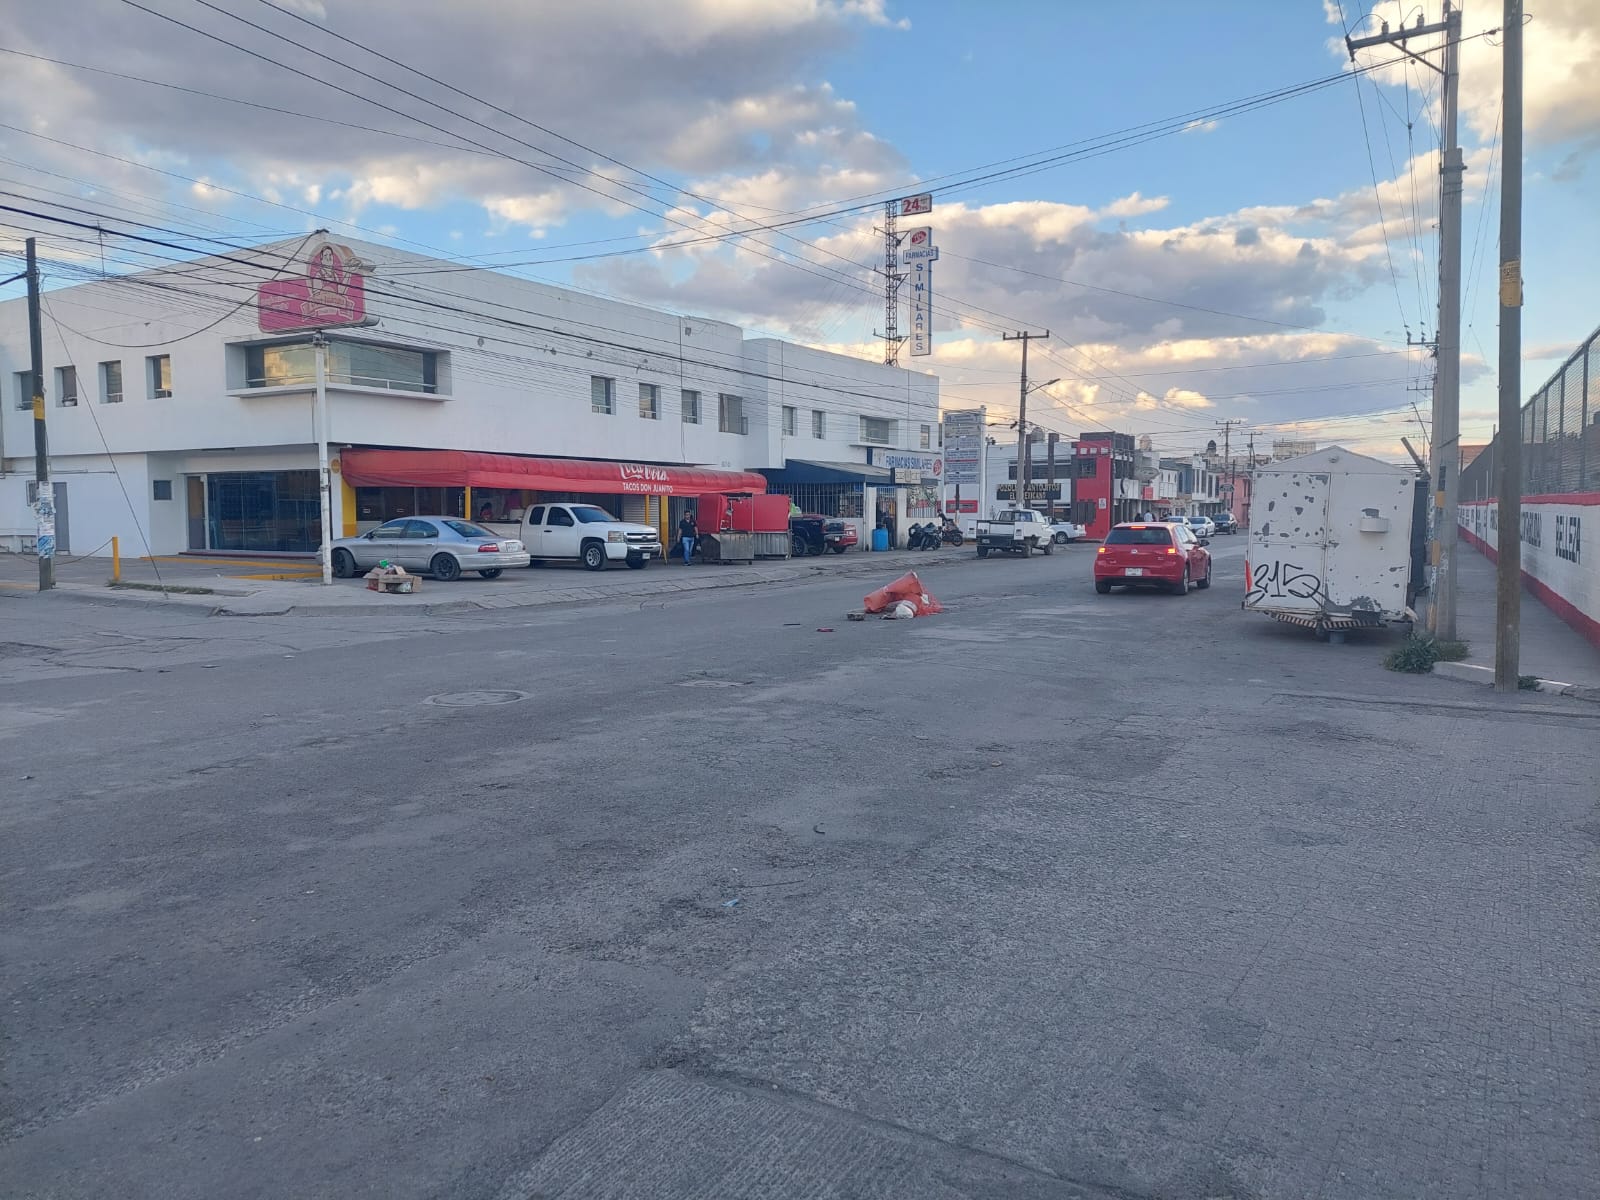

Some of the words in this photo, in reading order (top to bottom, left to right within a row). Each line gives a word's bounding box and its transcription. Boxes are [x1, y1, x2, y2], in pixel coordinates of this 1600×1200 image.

[903, 198, 920, 213] 24
[905, 249, 934, 260] FARMACIAS
[915, 263, 924, 351] SIMILARES
[886, 455, 910, 469] FARMACIAS
[910, 457, 932, 470] SIMILARES
[623, 482, 639, 491] TACOS
[640, 483, 651, 492] DON
[653, 484, 673, 493] JUANITO
[1024, 492, 1046, 500] EXICANO
[1555, 514, 1581, 565] BELLEZA
